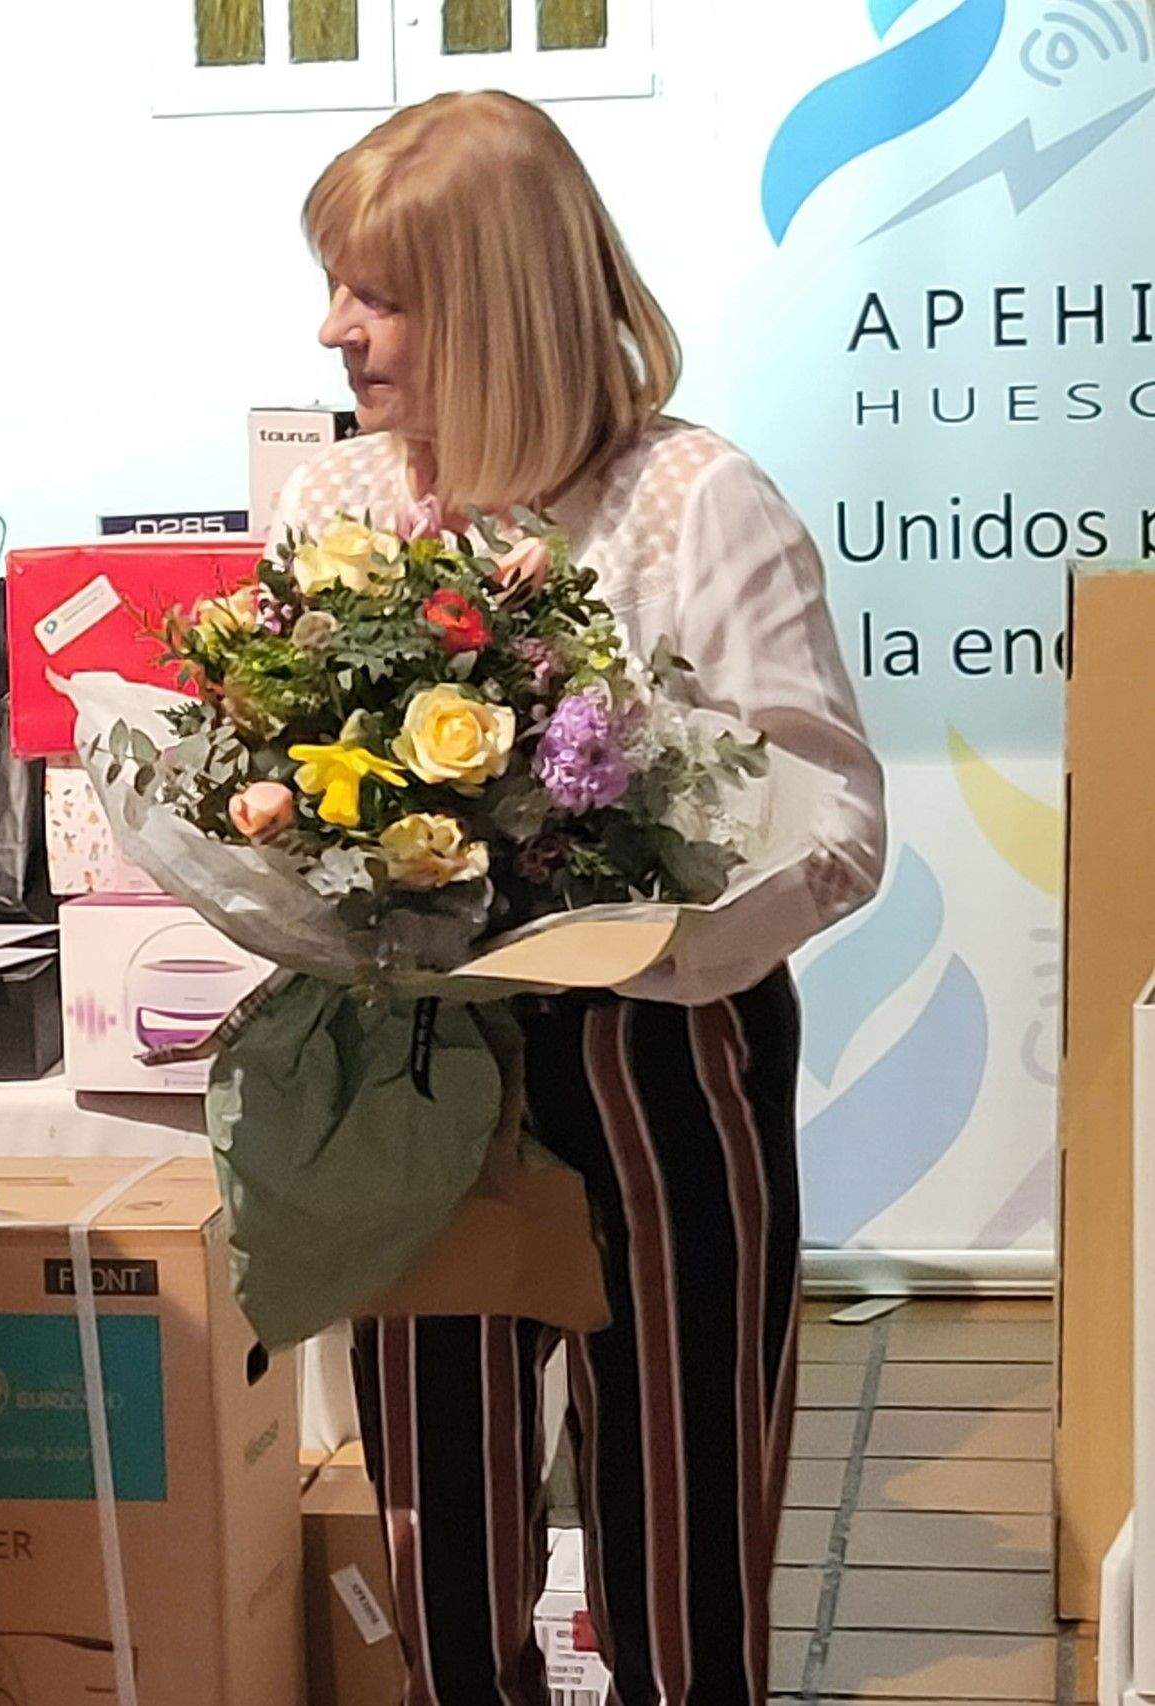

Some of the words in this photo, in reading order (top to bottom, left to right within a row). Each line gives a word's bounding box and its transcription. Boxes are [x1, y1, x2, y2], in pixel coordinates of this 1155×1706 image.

[846, 283, 1153, 352] APEHI
[259, 430, 321, 442] taurus
[837, 492, 1108, 563] Unidos
[862, 611, 919, 677] la
[58, 1266, 142, 1292] FONT
